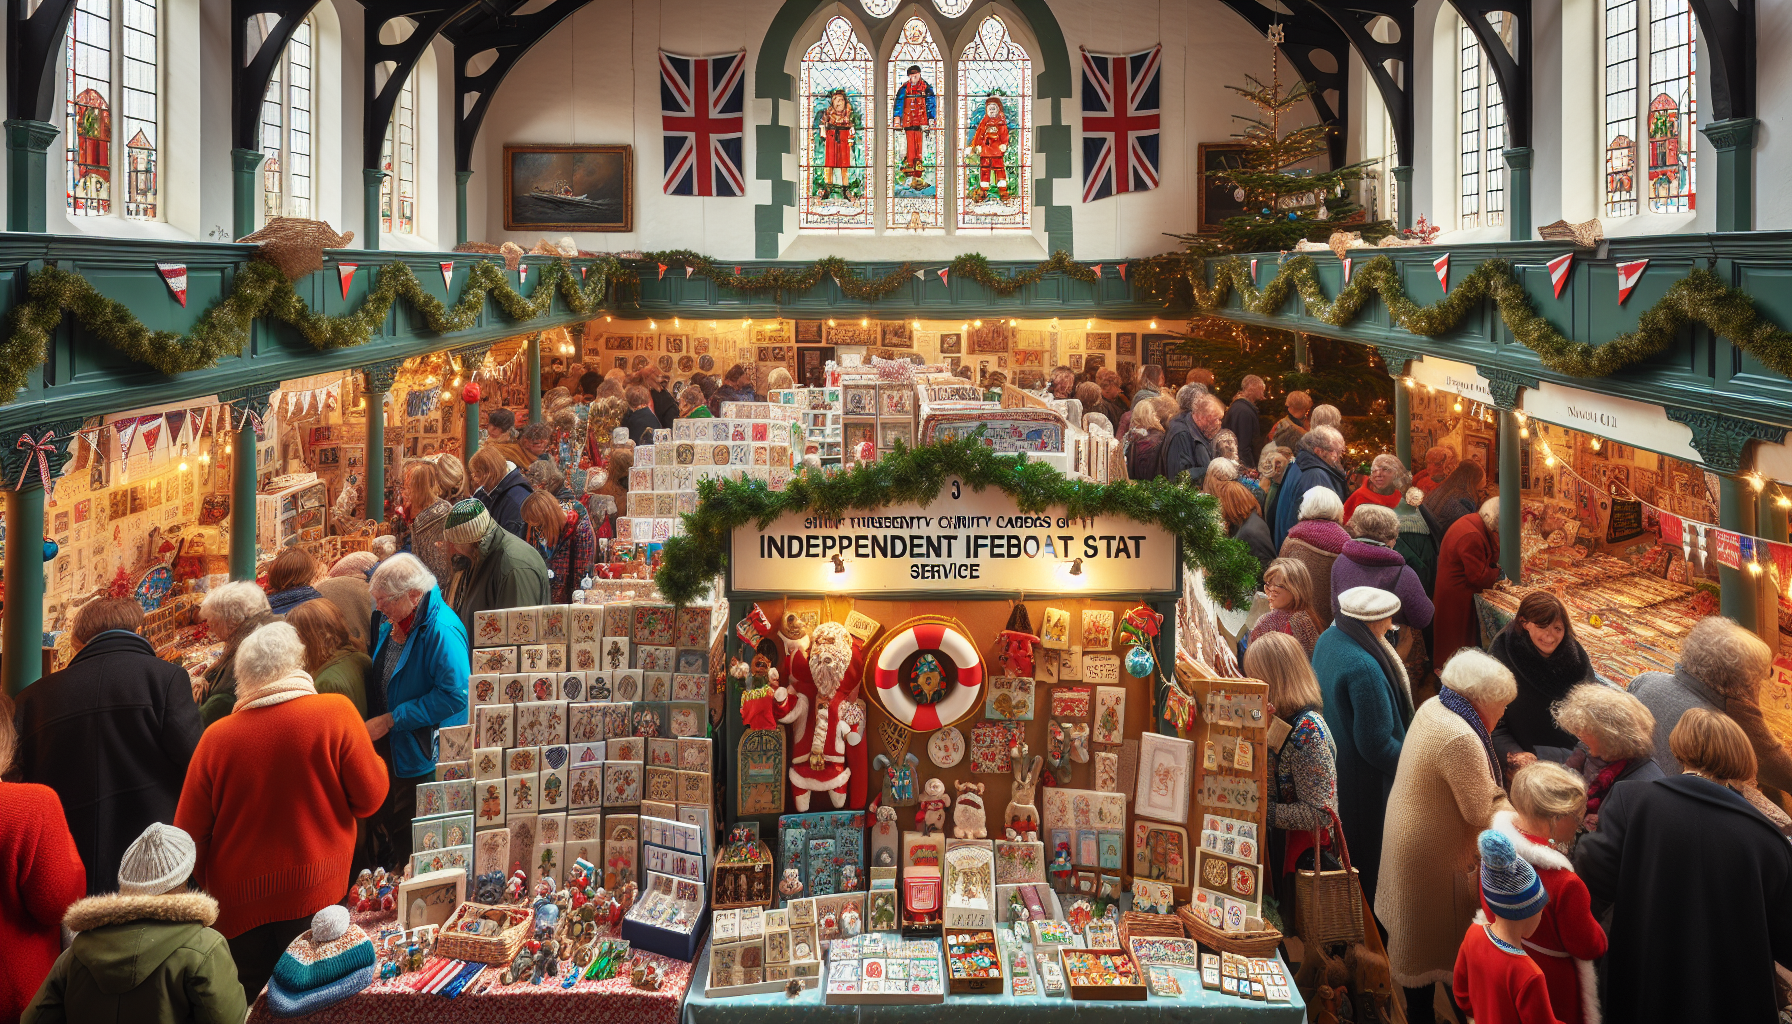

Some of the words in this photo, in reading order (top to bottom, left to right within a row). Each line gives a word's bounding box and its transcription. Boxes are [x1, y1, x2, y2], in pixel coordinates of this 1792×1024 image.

[760, 534, 958, 558] INDEPPENDENT
[965, 534, 1074, 558] IFEBOAT
[1083, 534, 1147, 558] STAT
[910, 562, 980, 580] SERVICE
